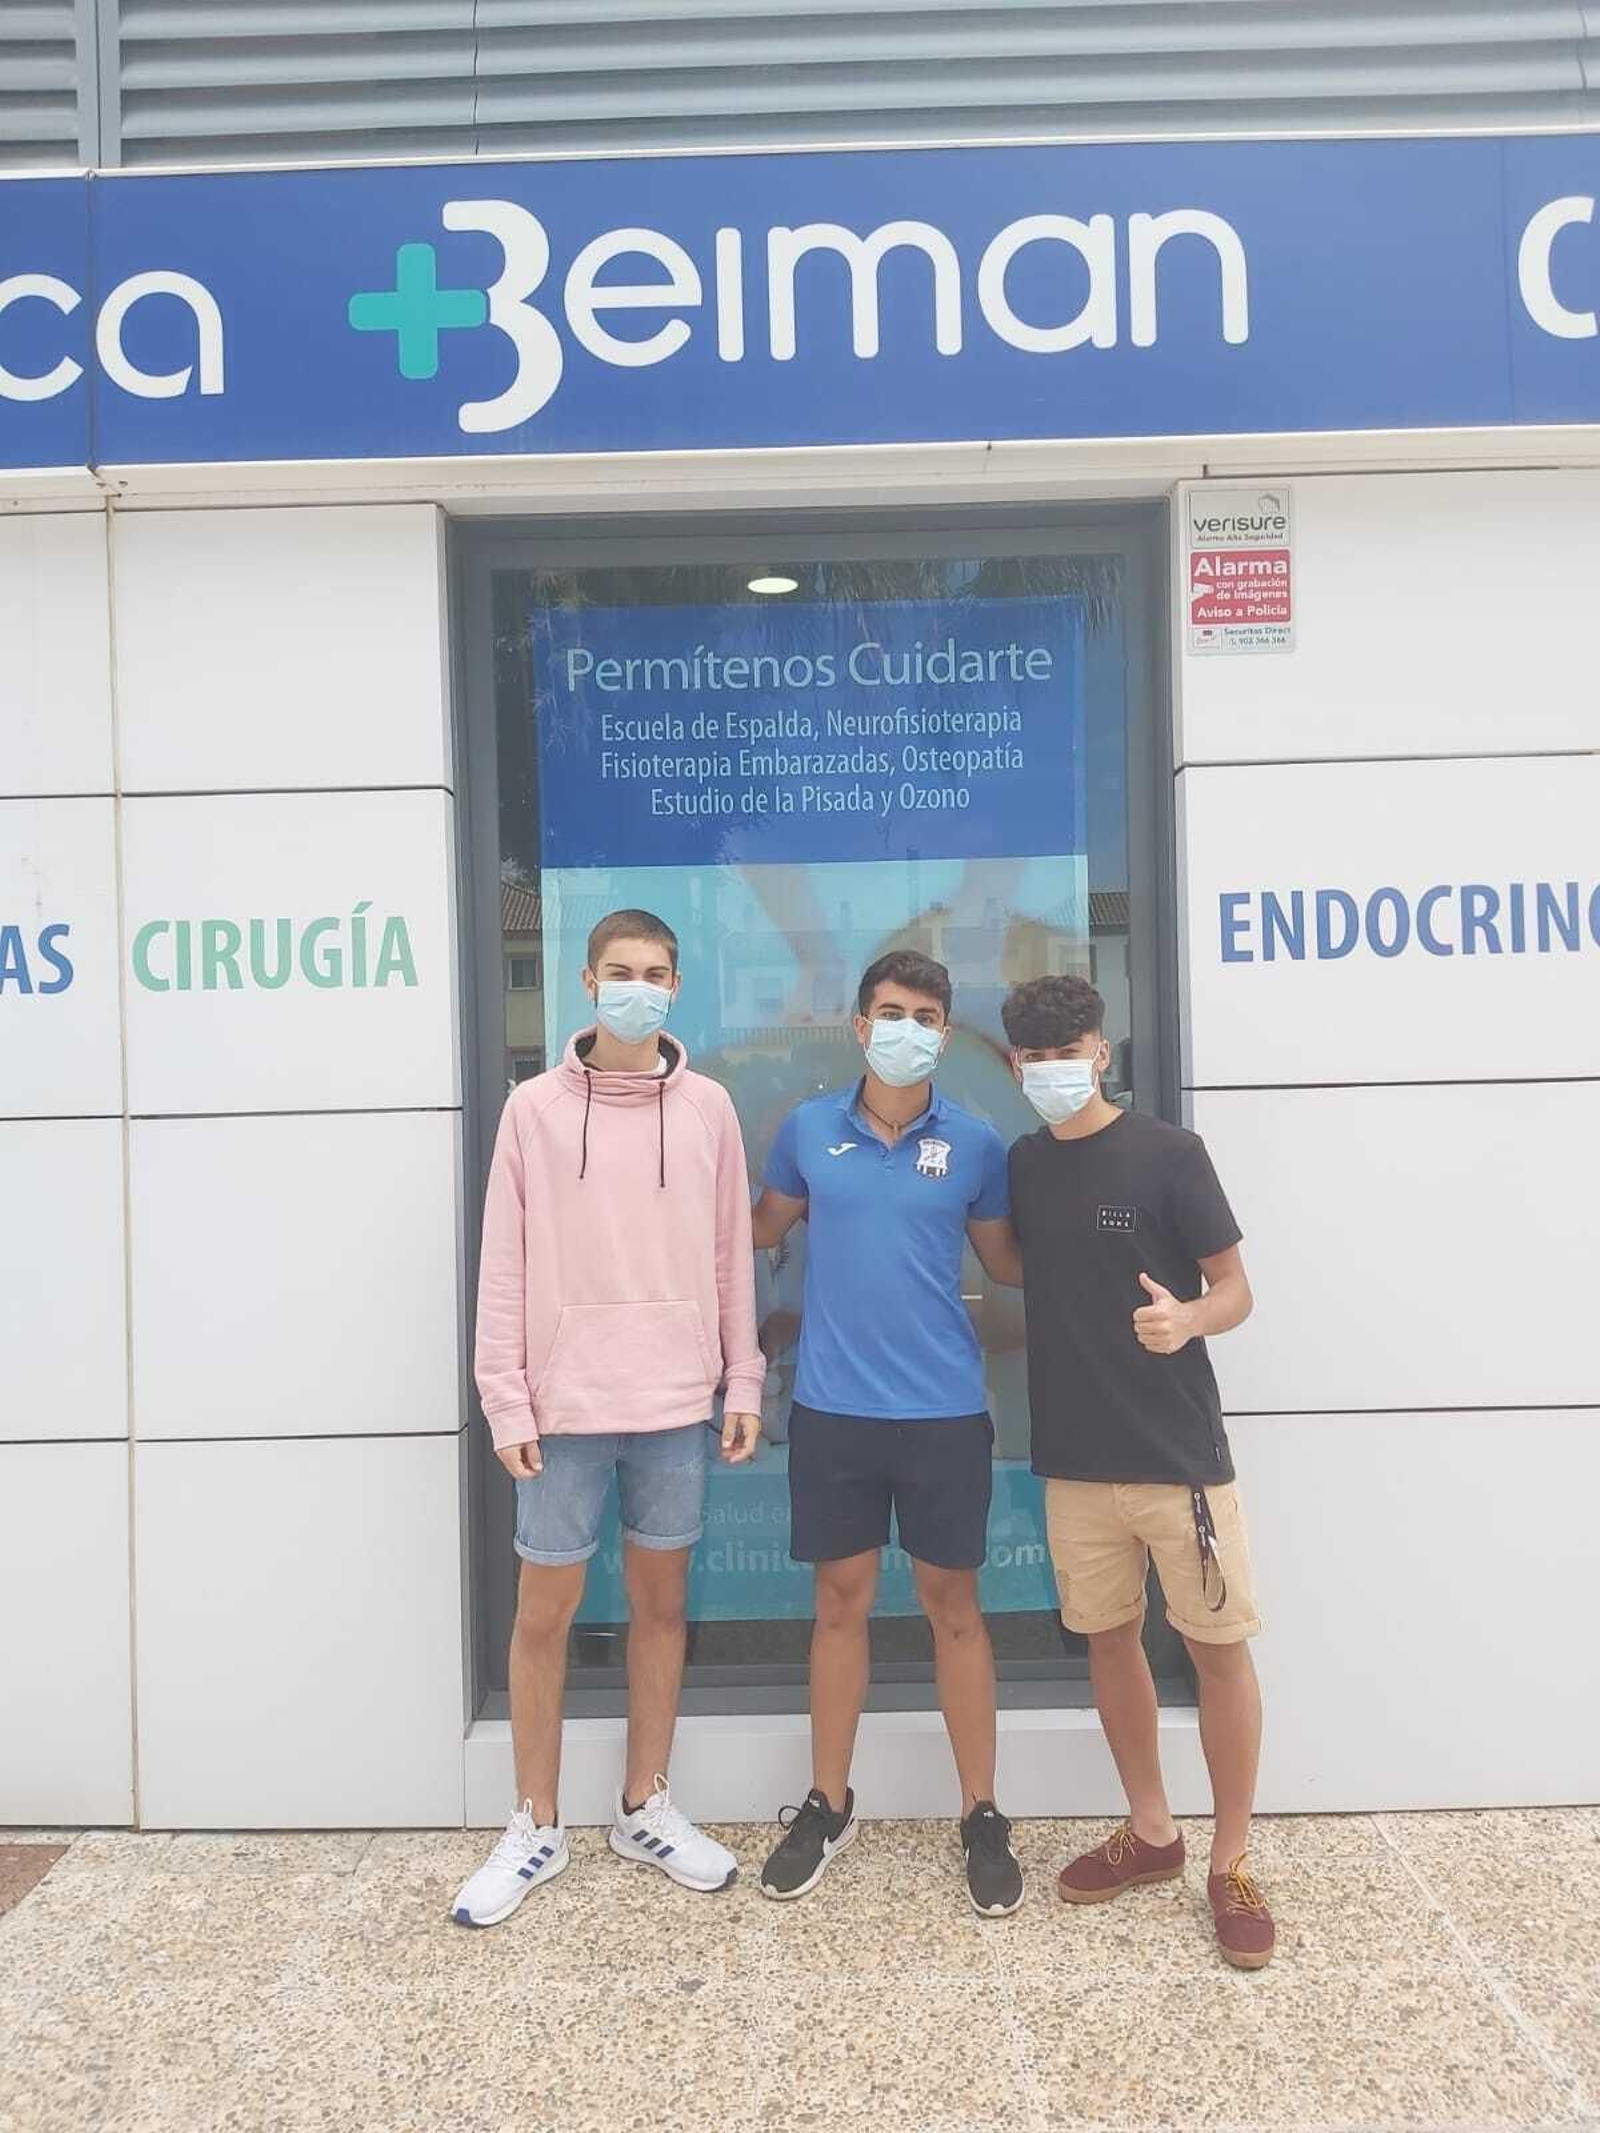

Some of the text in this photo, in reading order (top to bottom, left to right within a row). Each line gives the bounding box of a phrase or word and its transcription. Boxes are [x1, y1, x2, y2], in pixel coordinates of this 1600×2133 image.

[443, 199, 1249, 433] Beiman
[1193, 515, 1286, 532] verisure
[1194, 555, 1287, 576] Alarma
[1216, 578, 1287, 591] con grabación
[1197, 606, 1232, 618] Aviso
[1236, 608, 1243, 617] a
[1216, 589, 1231, 600] de
[567, 638, 1052, 692] Permítenos Cuidarte
[601, 705, 1021, 745] Escuela de Espalda, Neurofisioterapia
[601, 742, 1024, 784] Fisioterapia Embarazadas, Osteopatía
[651, 782, 970, 817] Estudio de la Pisada y Ozono
[1219, 881, 1600, 963] ENDOCRIN
[0, 924, 74, 995] AS
[132, 901, 418, 992] CIRUGÍA
